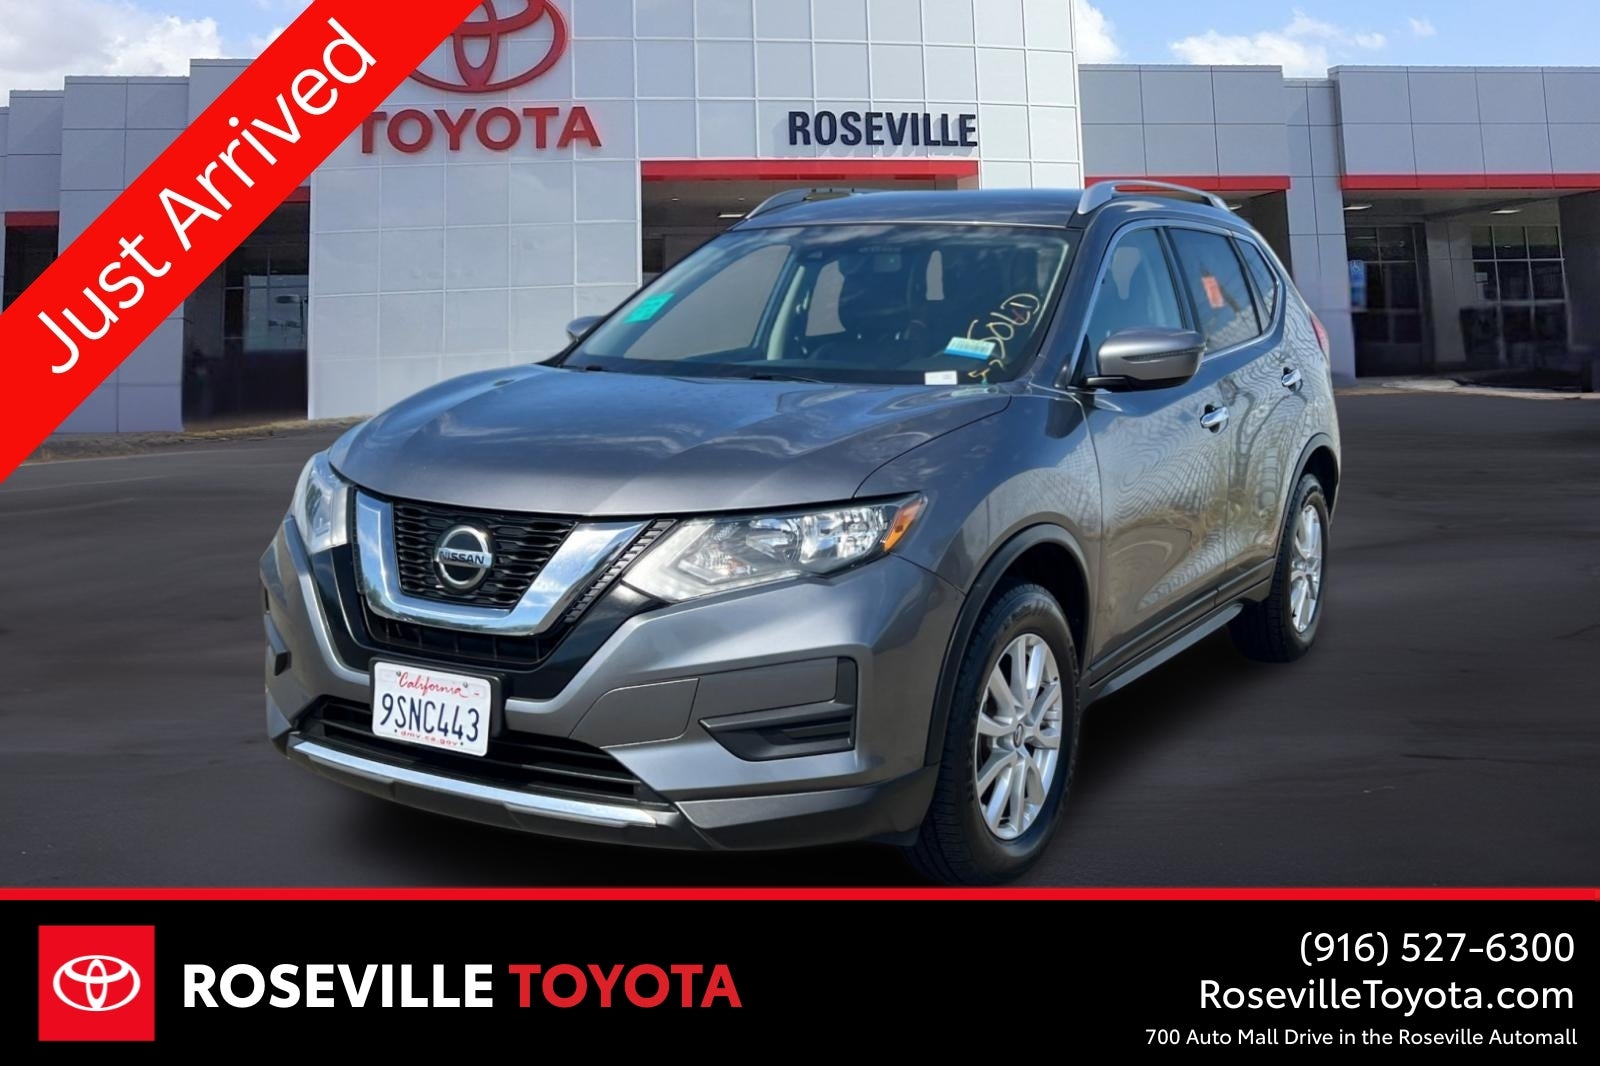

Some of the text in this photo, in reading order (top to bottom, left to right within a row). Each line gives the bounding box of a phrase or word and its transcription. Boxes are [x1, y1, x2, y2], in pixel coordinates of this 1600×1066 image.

[361, 106, 602, 154] TOYOTA
[788, 110, 978, 147] ROSEVILLE
[439, 550, 485, 565] NISSAN
[398, 671, 469, 698] California
[380, 692, 480, 743] 9SNC443
